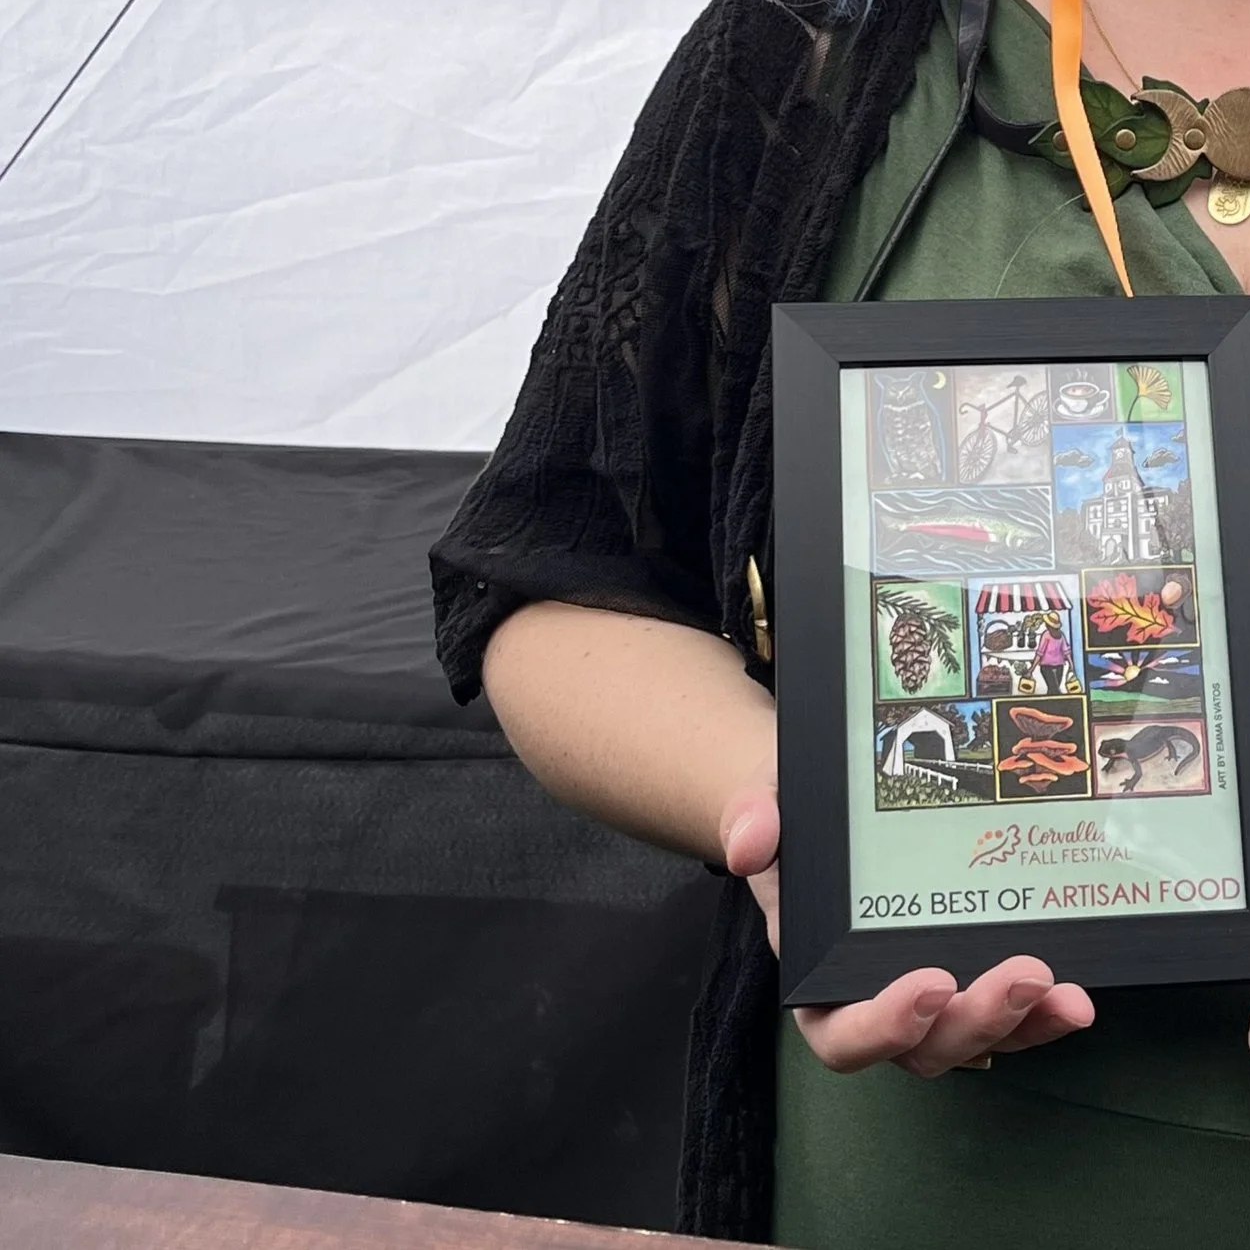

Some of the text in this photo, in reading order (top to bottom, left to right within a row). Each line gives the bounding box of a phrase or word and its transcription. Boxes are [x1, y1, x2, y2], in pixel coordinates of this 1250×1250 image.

[1212, 682, 1227, 790] ART BY EMMA SVATOS
[1028, 821, 1106, 847] Corvallis
[1020, 846, 1133, 866] FALL FESTIVAL
[859, 877, 1240, 919] 2026 BEST OF ARTISAN FOOD
